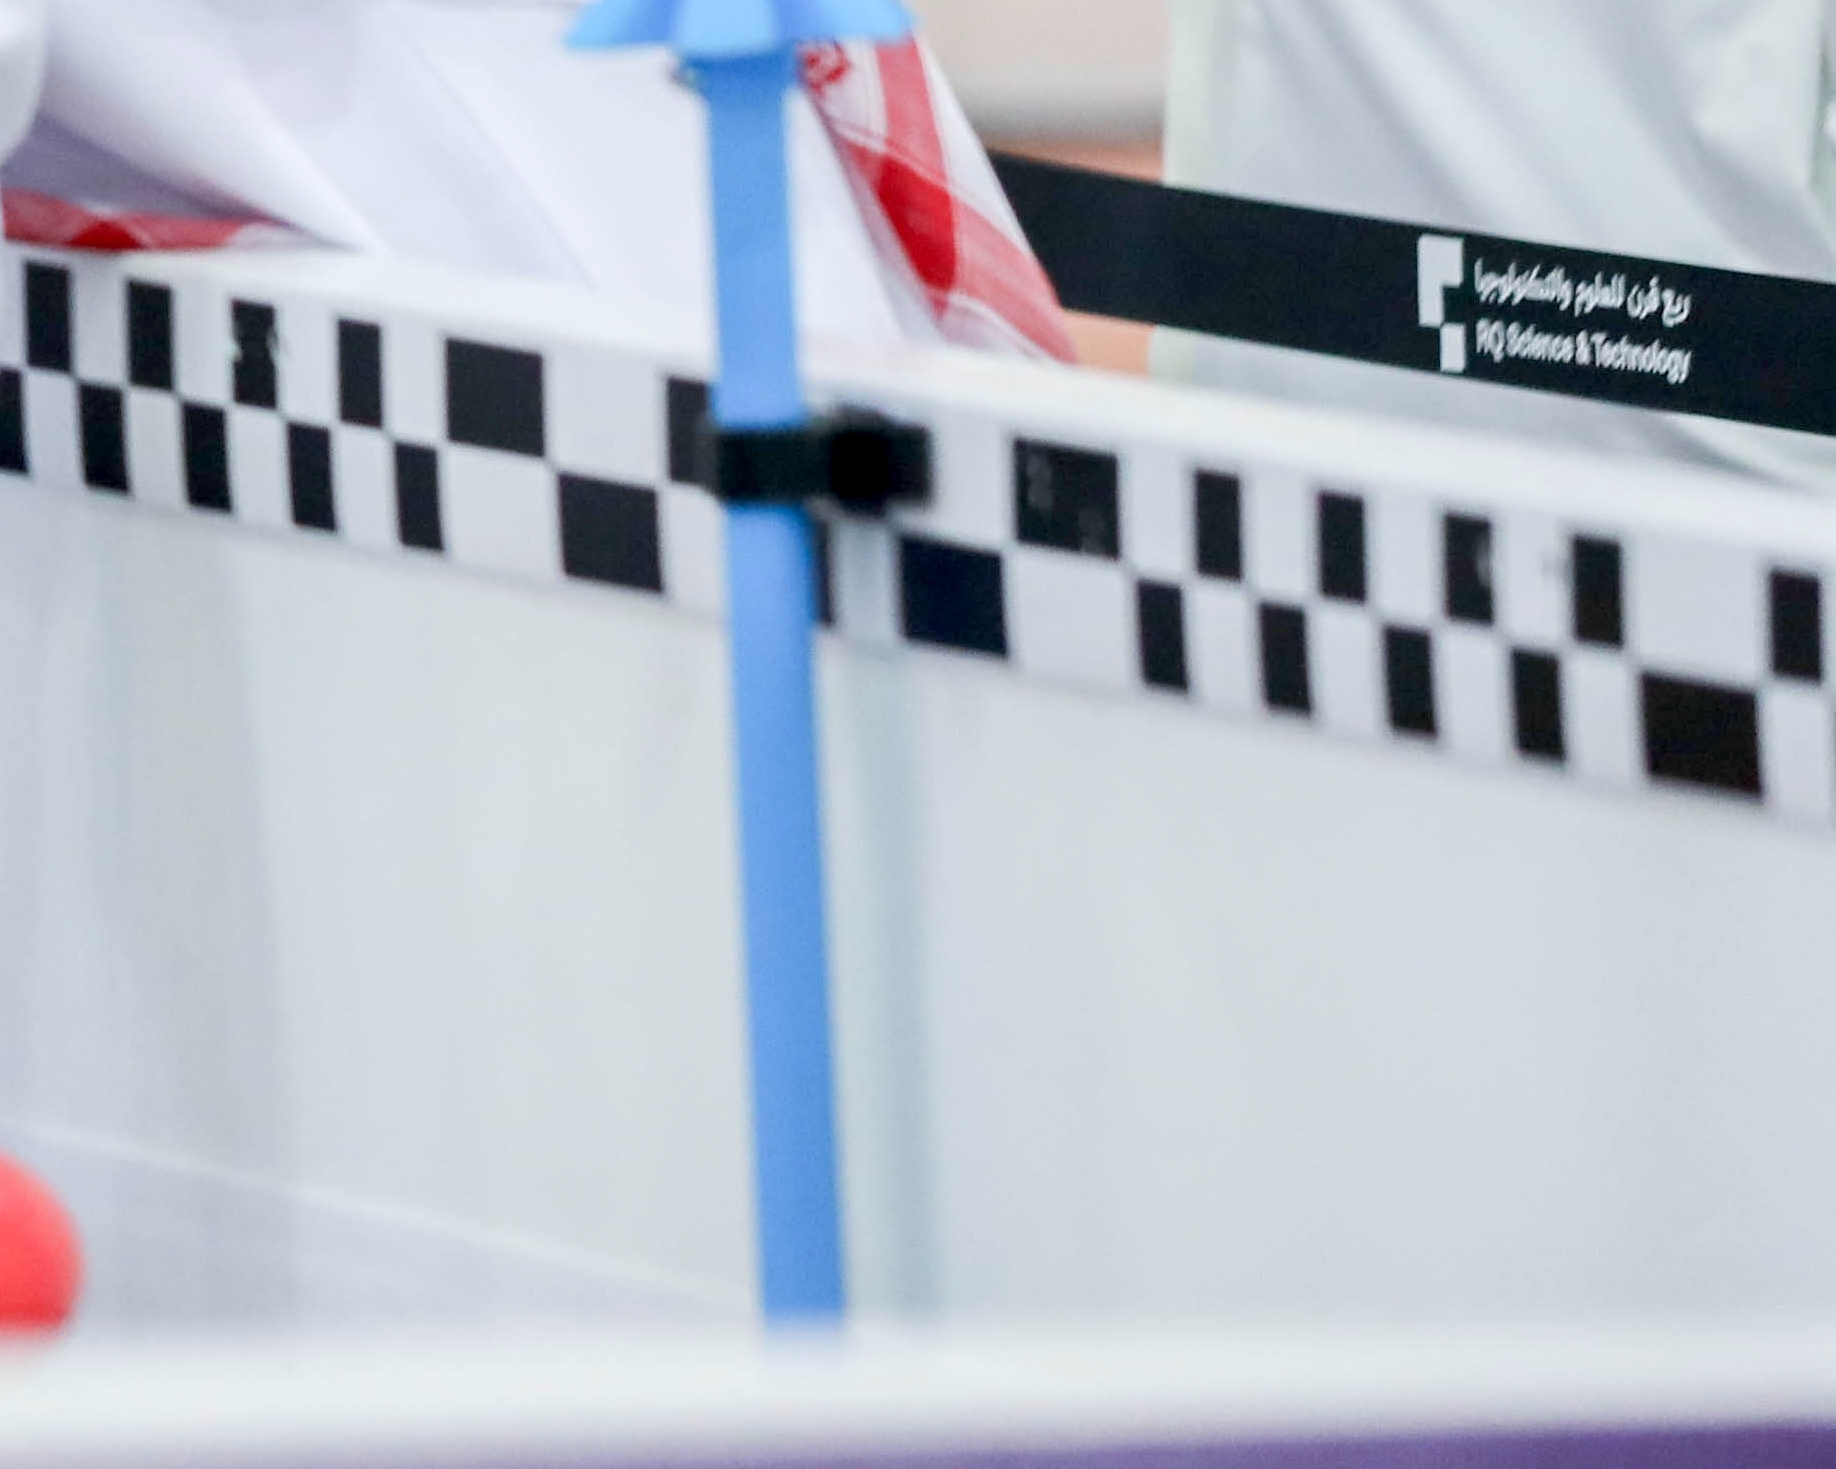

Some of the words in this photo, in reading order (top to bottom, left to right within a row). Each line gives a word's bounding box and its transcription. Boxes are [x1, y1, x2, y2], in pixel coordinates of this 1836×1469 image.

[1662, 288, 1692, 328] ربع
[1476, 317, 1505, 363] RQ
[1505, 320, 1575, 363] Science
[1575, 329, 1592, 365] &
[1591, 331, 1693, 385] Technology
